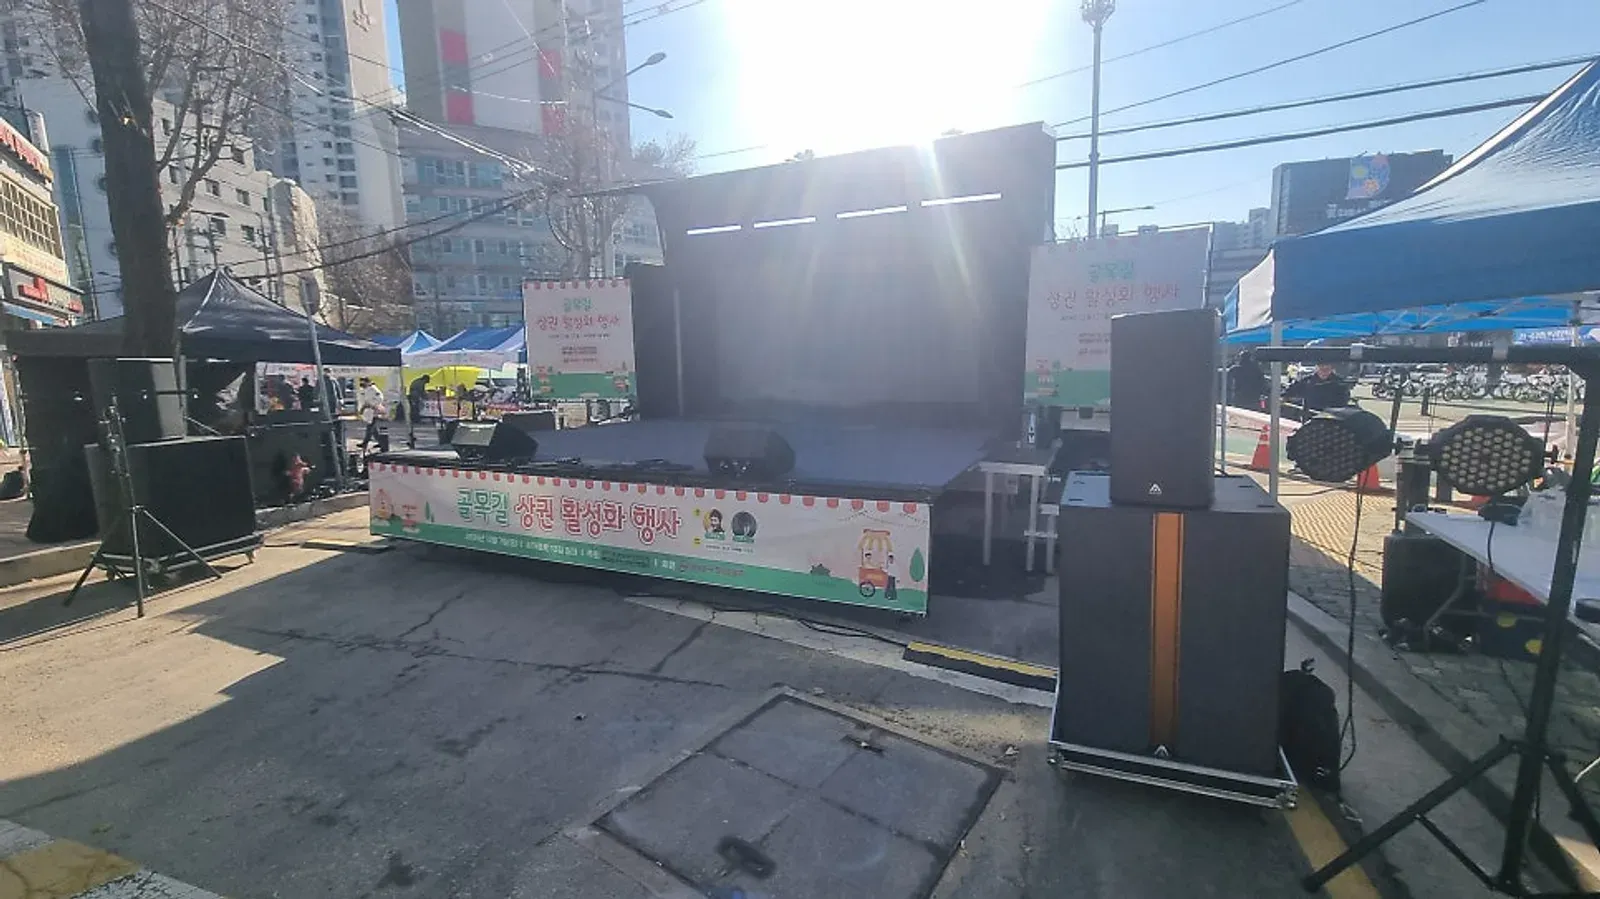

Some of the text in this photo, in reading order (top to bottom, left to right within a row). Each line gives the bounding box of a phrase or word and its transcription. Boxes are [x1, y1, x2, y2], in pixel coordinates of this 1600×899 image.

[457, 487, 683, 545] 골목길 상권 활성화 행사
